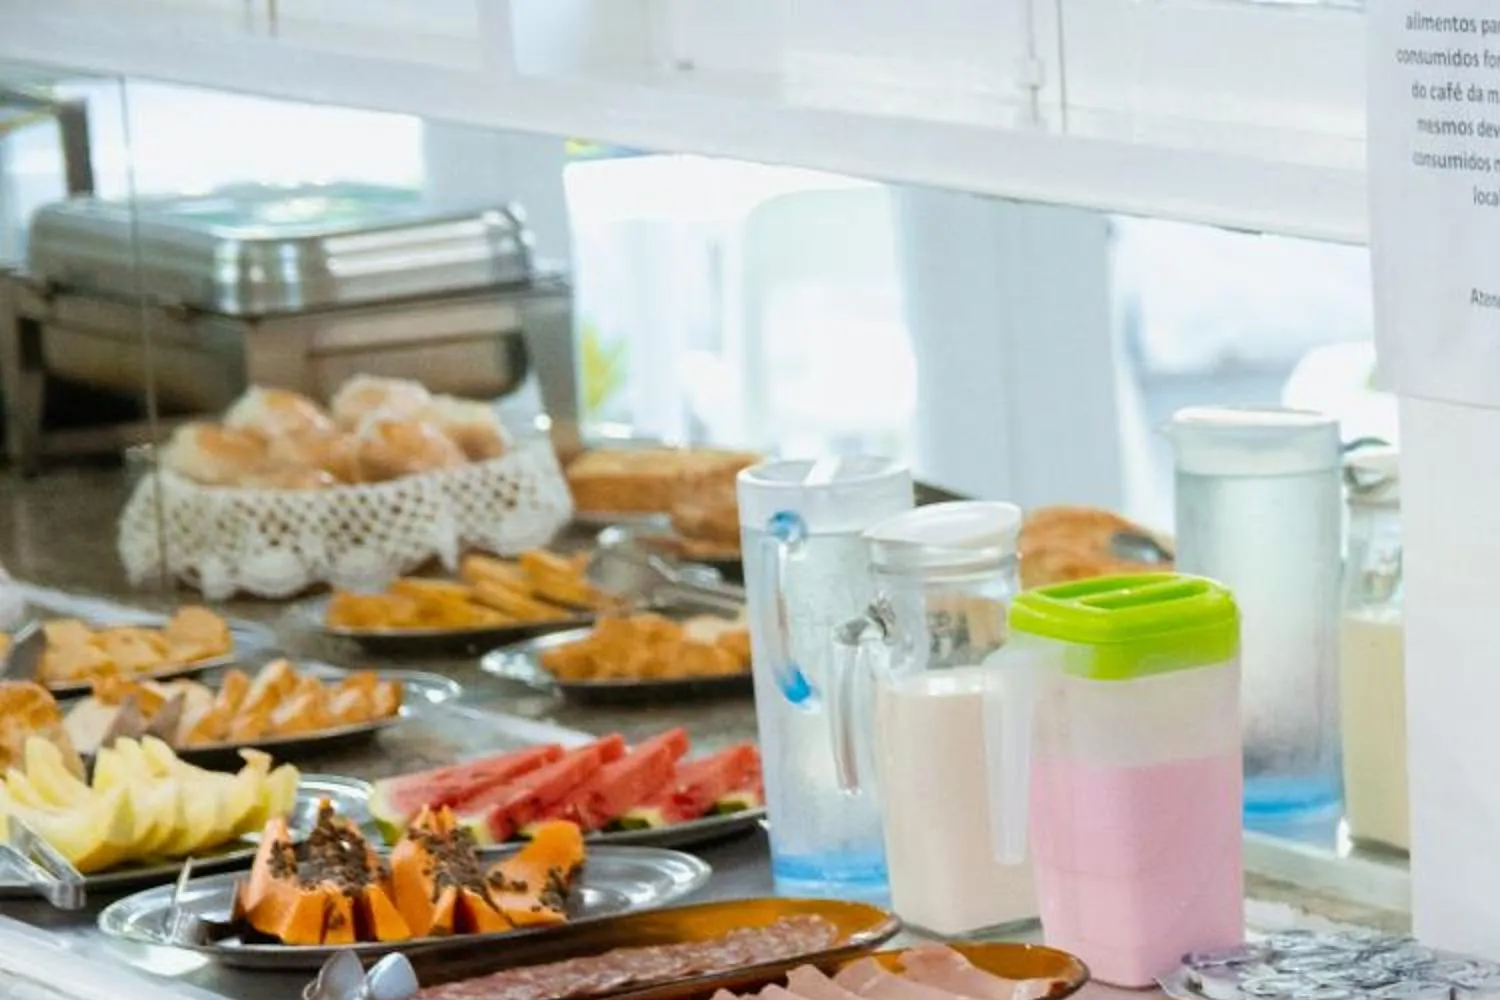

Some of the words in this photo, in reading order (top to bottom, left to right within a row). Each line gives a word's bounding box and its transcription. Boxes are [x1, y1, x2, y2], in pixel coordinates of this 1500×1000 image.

[1405, 9, 1477, 33] alimentos
[1396, 48, 1480, 68] consumidos
[1411, 80, 1427, 100] do
[1429, 81, 1463, 102] café
[1466, 82, 1483, 103] da
[1417, 118, 1474, 136] mesmos
[1412, 151, 1492, 174] consumidos
